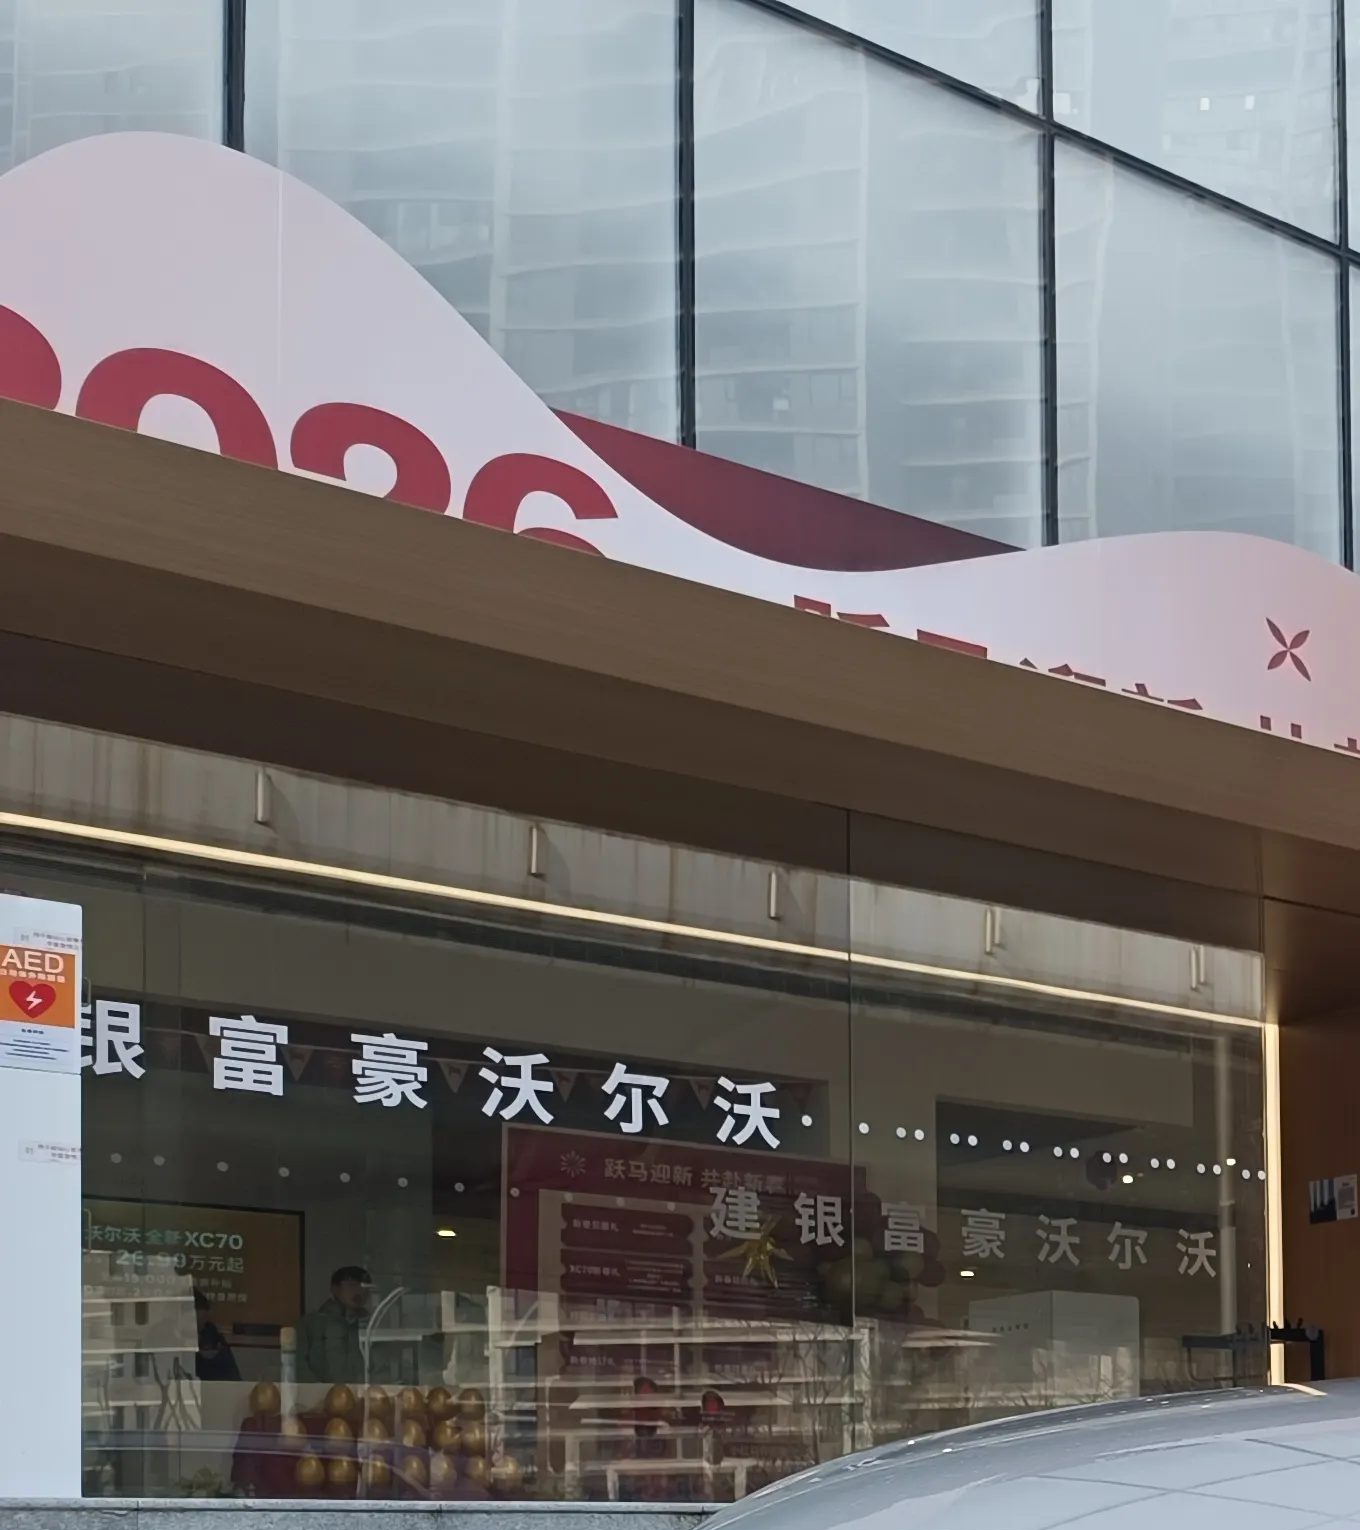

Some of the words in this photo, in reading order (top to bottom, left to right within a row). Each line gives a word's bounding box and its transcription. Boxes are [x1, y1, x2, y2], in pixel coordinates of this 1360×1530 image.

[1, 948, 64, 974] AED
[604, 1157, 694, 1187] 跃马迎新
[708, 1186, 1218, 1279] 建银富豪沃尔沃
